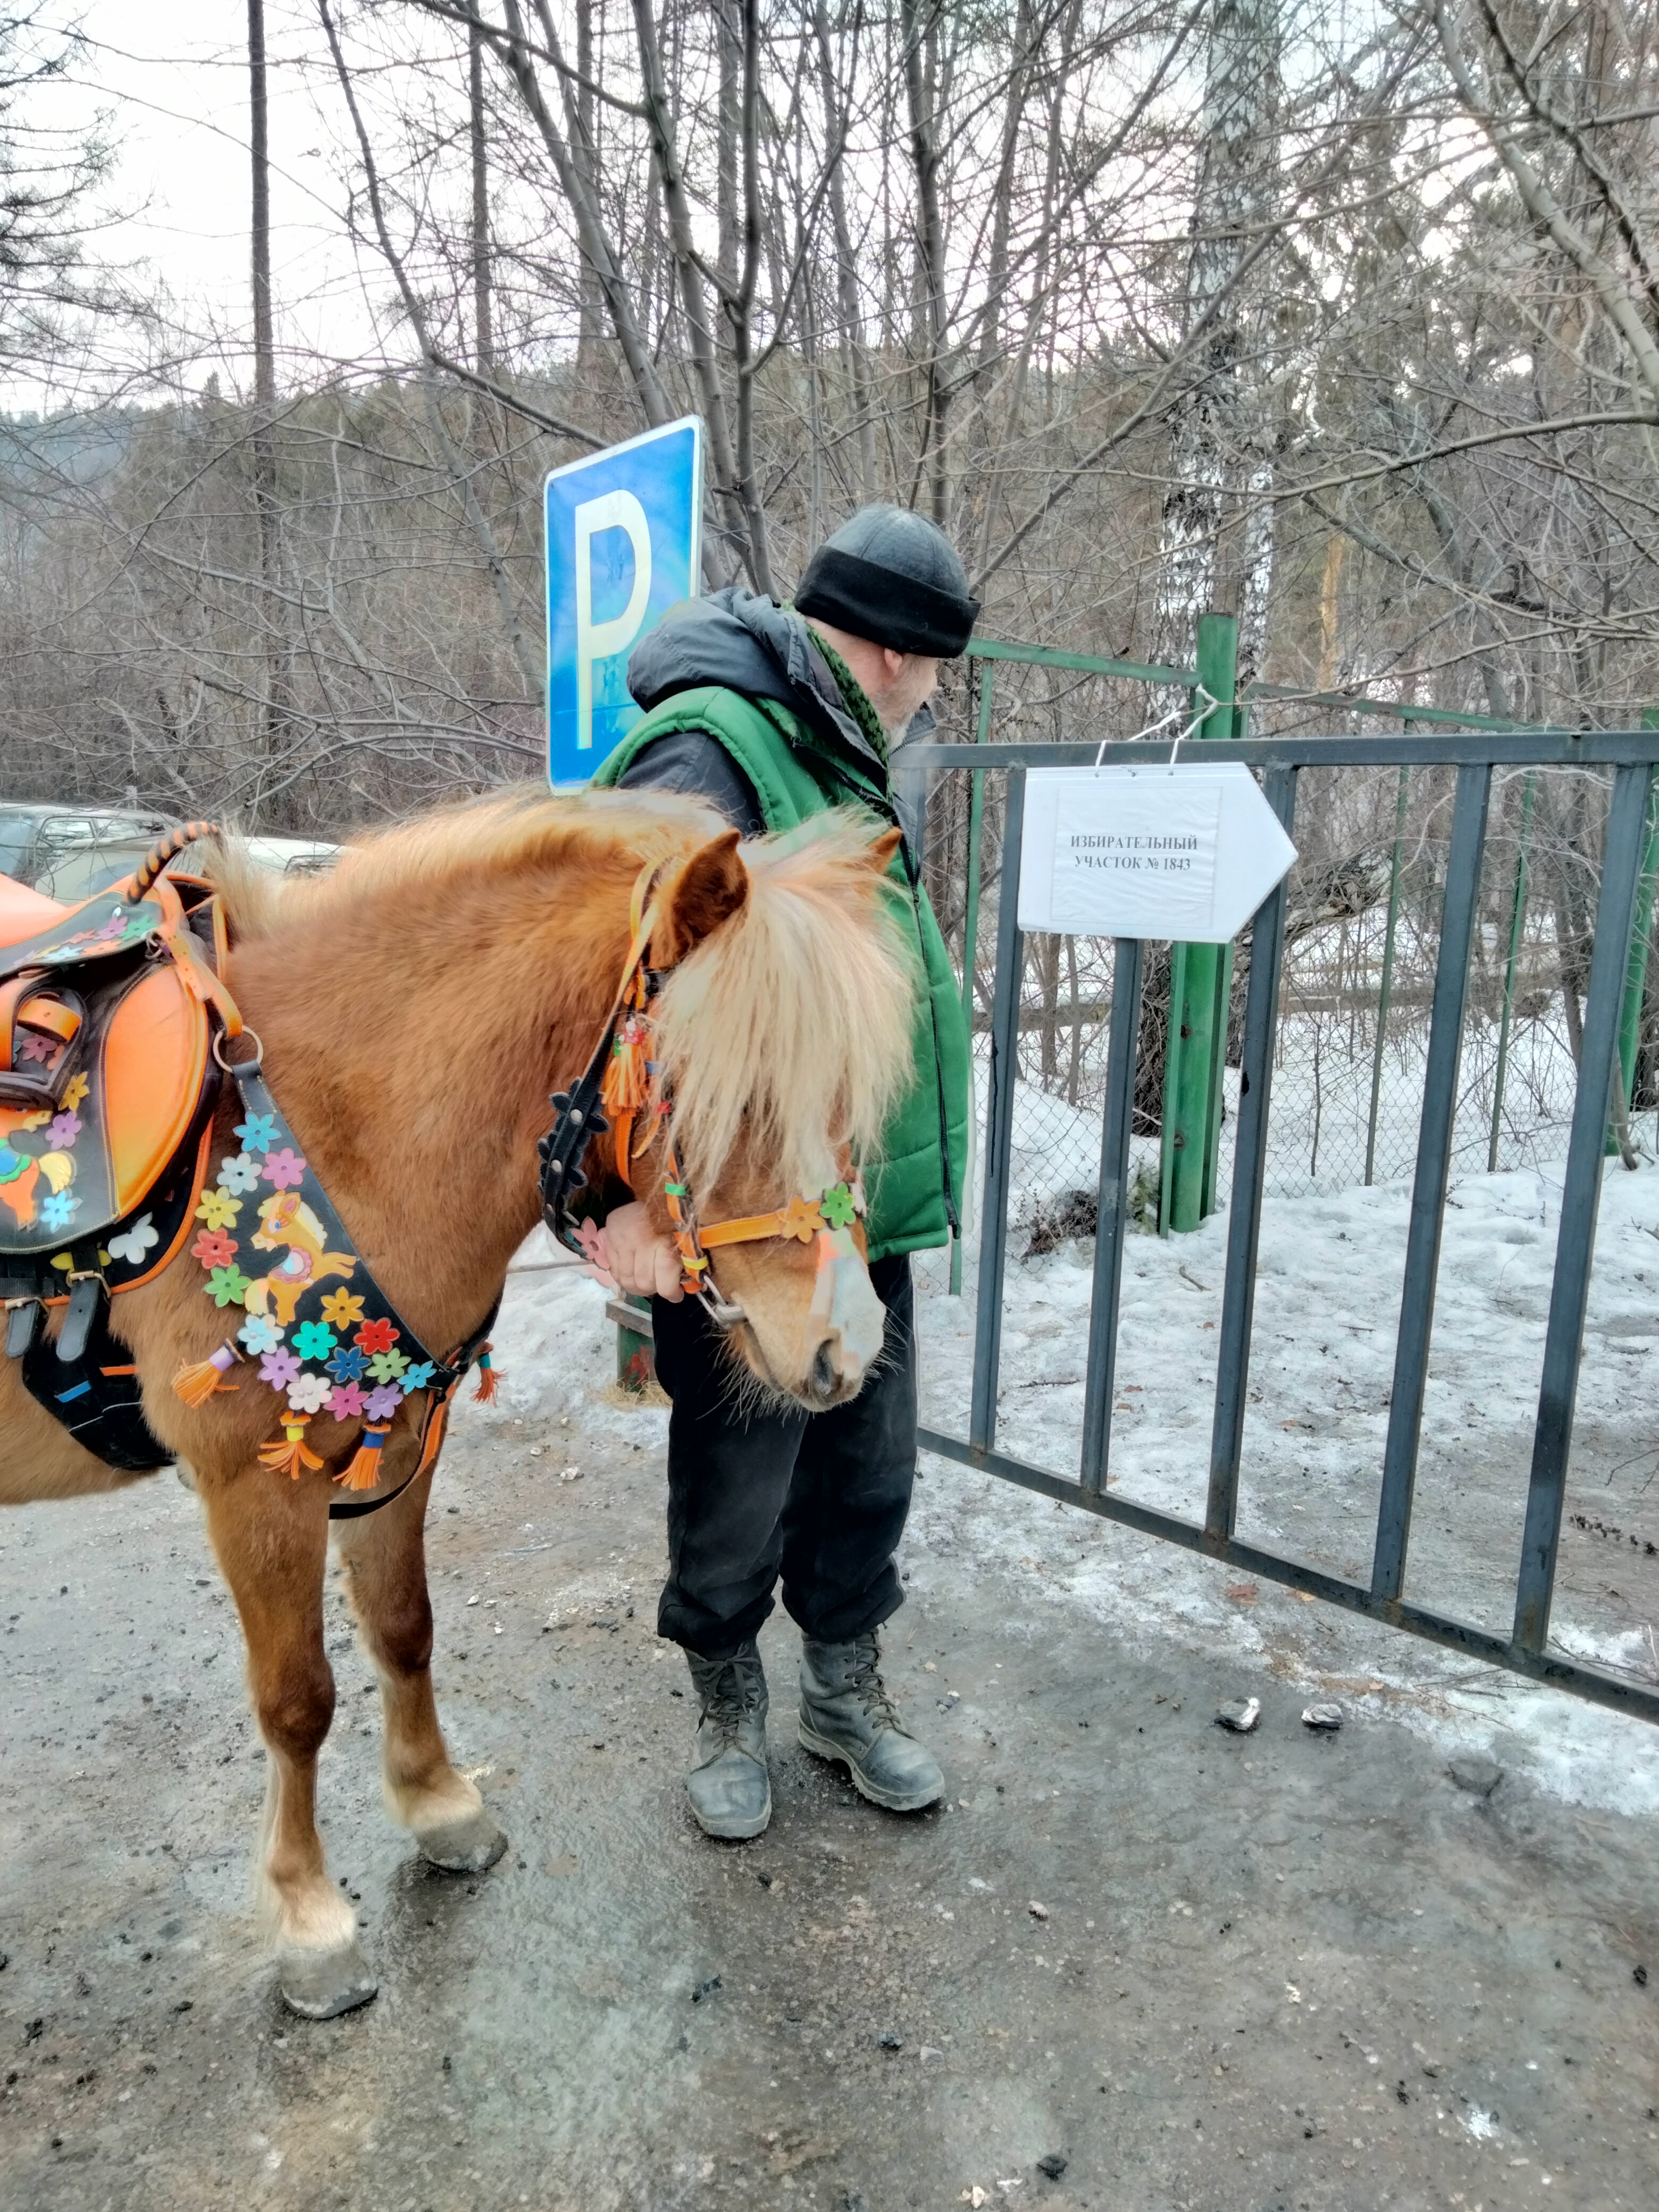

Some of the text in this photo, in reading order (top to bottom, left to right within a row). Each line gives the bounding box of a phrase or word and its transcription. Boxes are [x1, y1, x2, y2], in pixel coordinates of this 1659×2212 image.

[575, 489, 652, 750] P
[1070, 834, 1198, 850] ИЗБИРАТЕЛЬНЫЙ
[1075, 856, 1191, 871] УЧАСТОК № 1843
